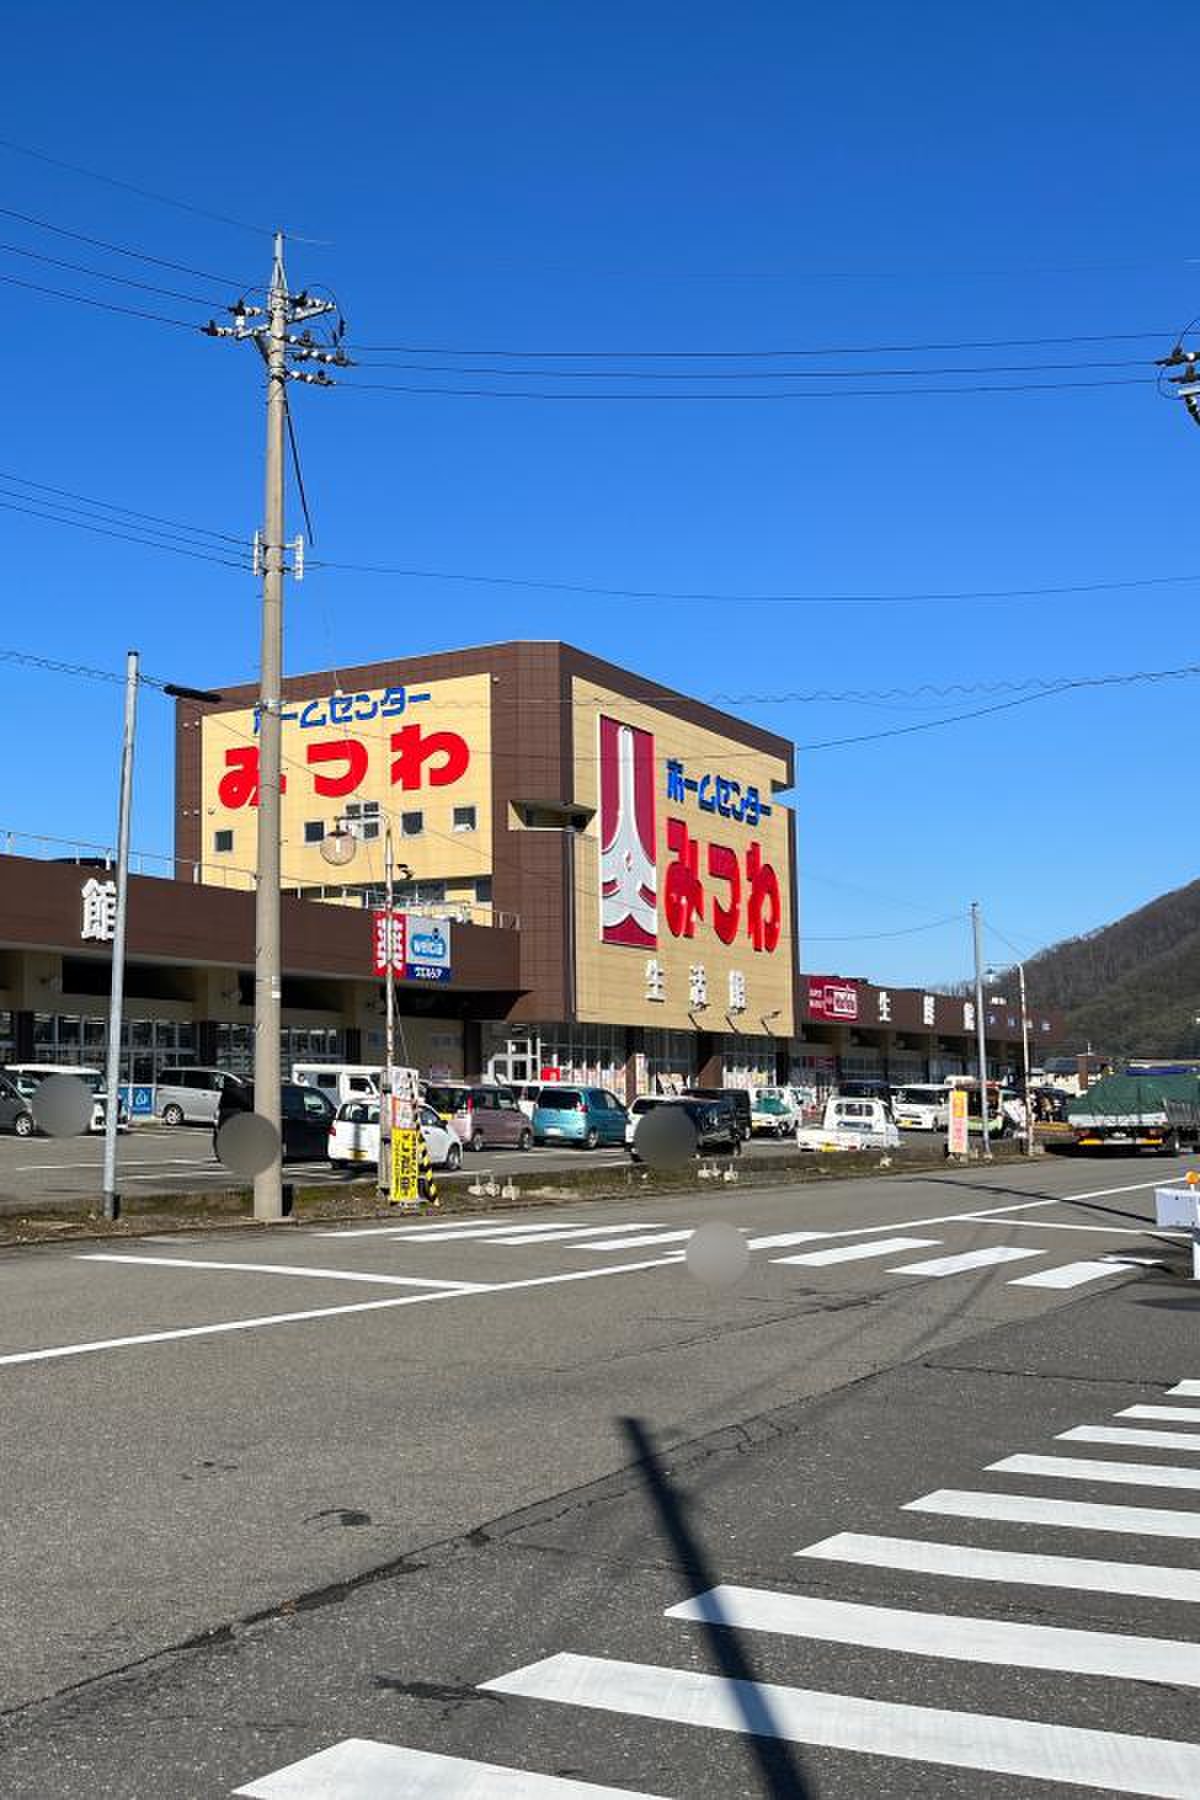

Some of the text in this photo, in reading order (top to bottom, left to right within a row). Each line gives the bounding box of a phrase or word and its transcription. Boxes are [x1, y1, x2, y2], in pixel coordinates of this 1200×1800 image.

[218, 723, 470, 810] みつわ
[666, 758, 773, 826] ホームセンター
[664, 817, 781, 953] みつわ
